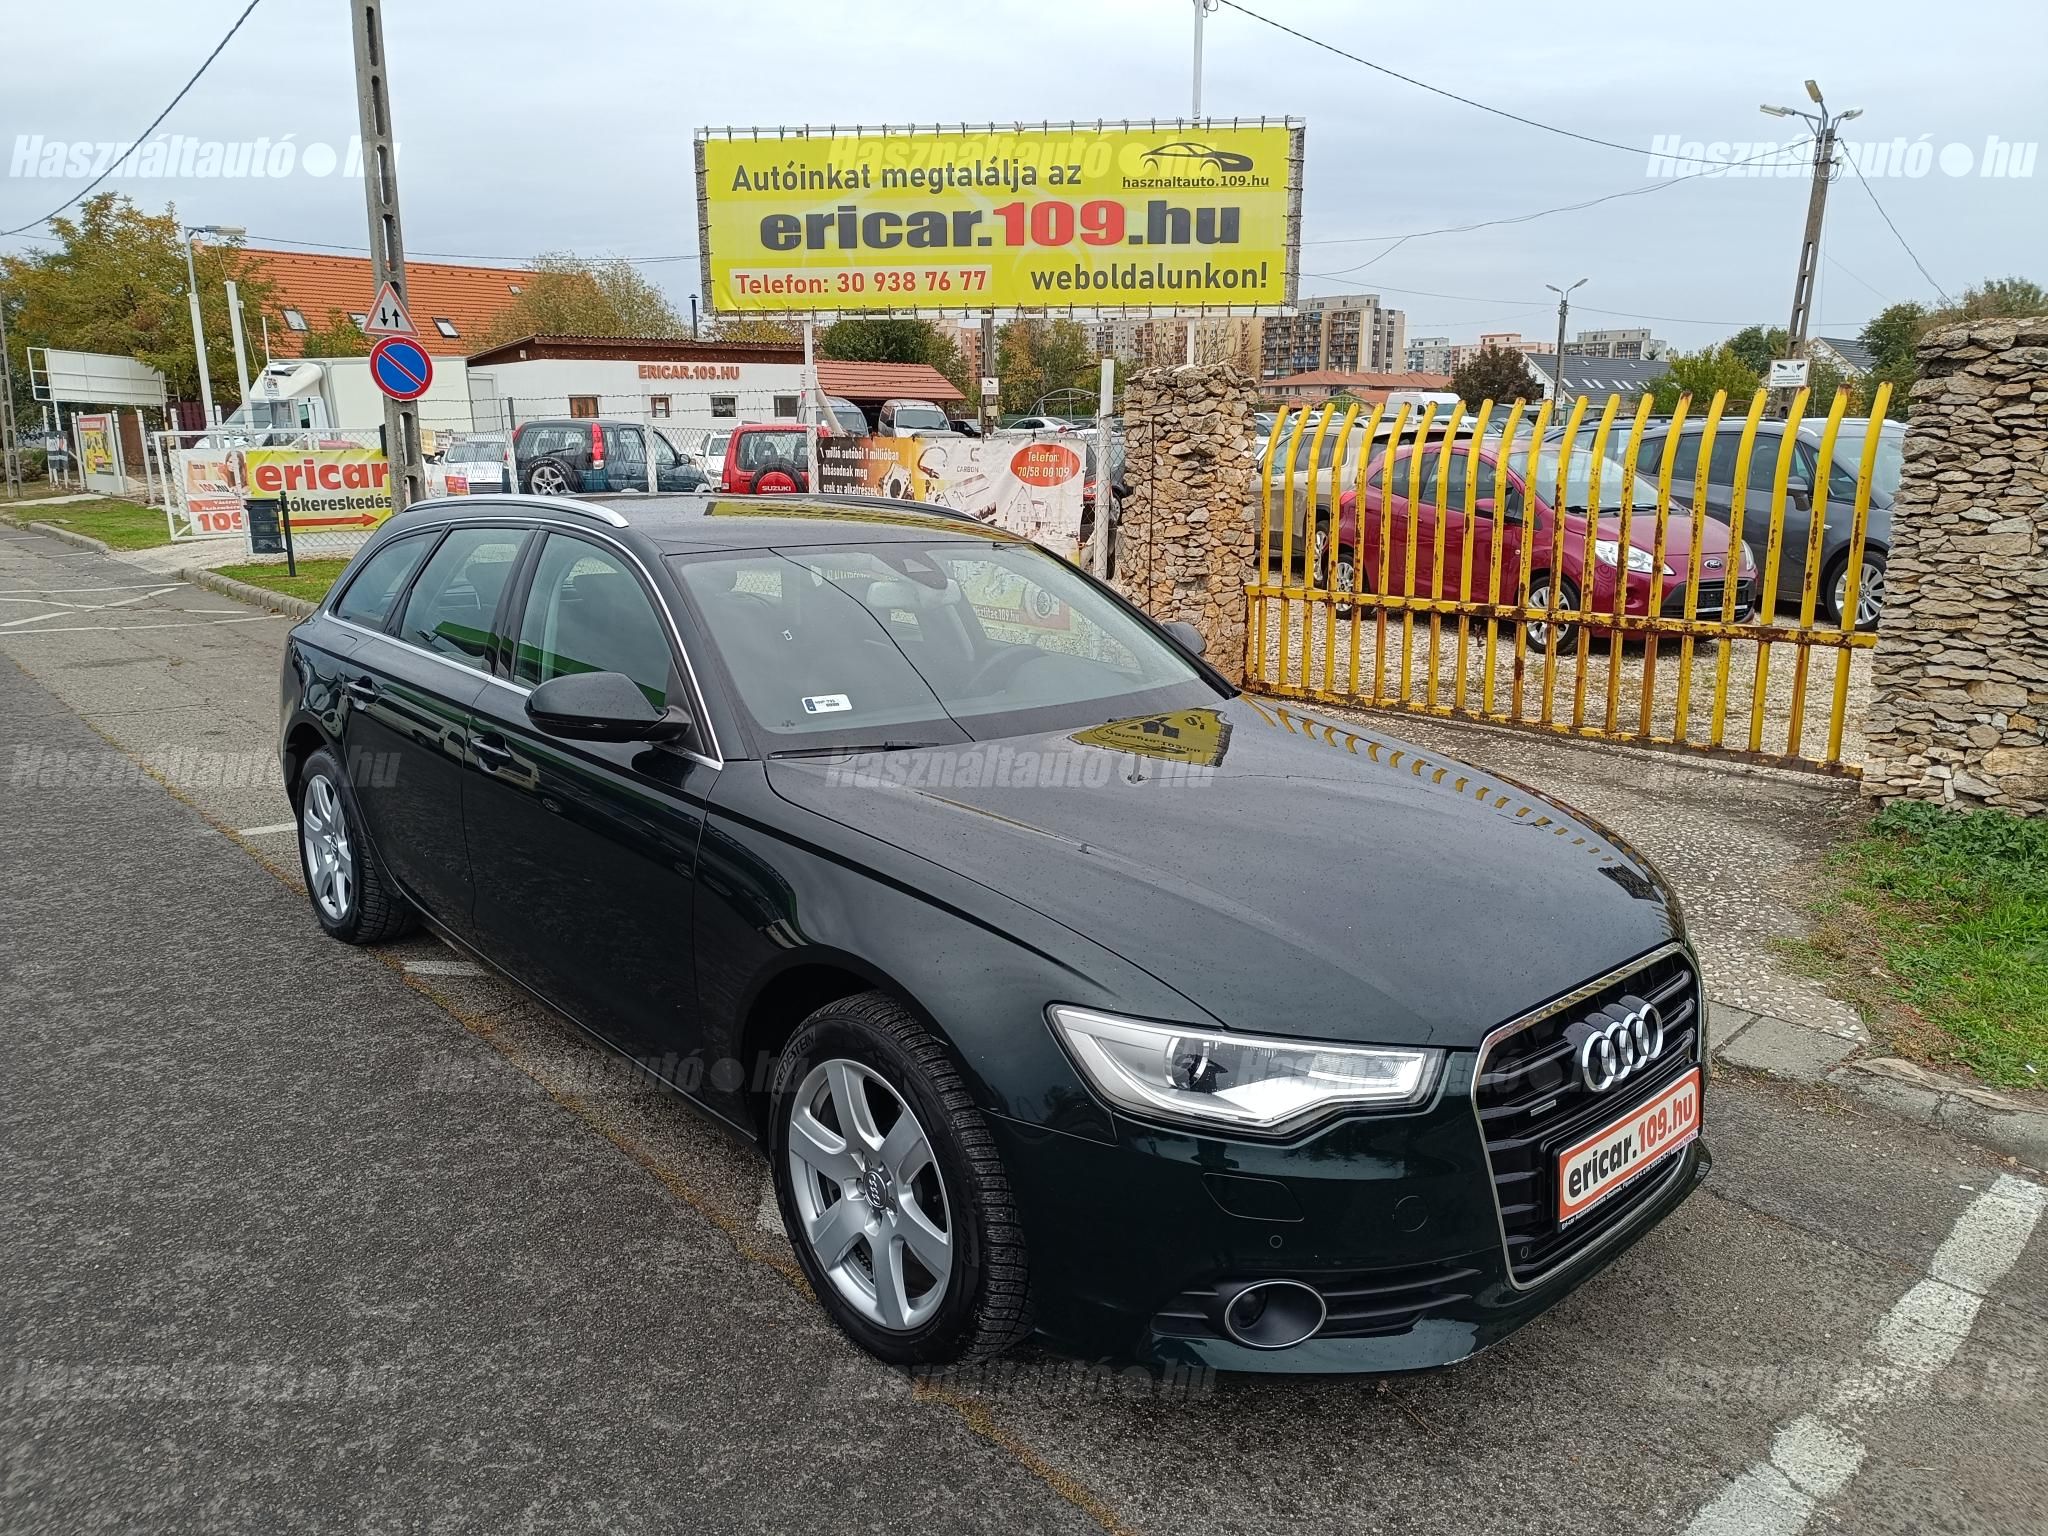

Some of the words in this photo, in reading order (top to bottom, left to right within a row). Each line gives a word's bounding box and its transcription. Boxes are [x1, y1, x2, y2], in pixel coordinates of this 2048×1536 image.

[732, 159, 871, 192] Autóinkat
[882, 156, 1038, 194] megtalálja
[1048, 165, 1082, 185] az
[1122, 175, 1270, 188] hasznaltauto.109.hu
[760, 200, 1239, 251] ericar.109.hu
[735, 272, 829, 294] Telefon:
[837, 272, 866, 292] 30
[873, 272, 916, 291] 938
[924, 271, 953, 291] 76
[959, 270, 986, 291] 77
[1031, 261, 1268, 290] weboldalunkon!
[638, 364, 739, 380] ERICAR.109.HU
[842, 446, 864, 460] autóból
[1028, 451, 1060, 463] Telefon:
[255, 459, 389, 492] ericar
[823, 463, 853, 477] hibásodnak
[855, 468, 868, 480] meg
[1017, 466, 1040, 479] 70/58
[1056, 467, 1070, 478] 109
[823, 482, 836, 493] ezek
[837, 485, 843, 494] az
[1568, 1093, 1693, 1198] ericar.109.hu
